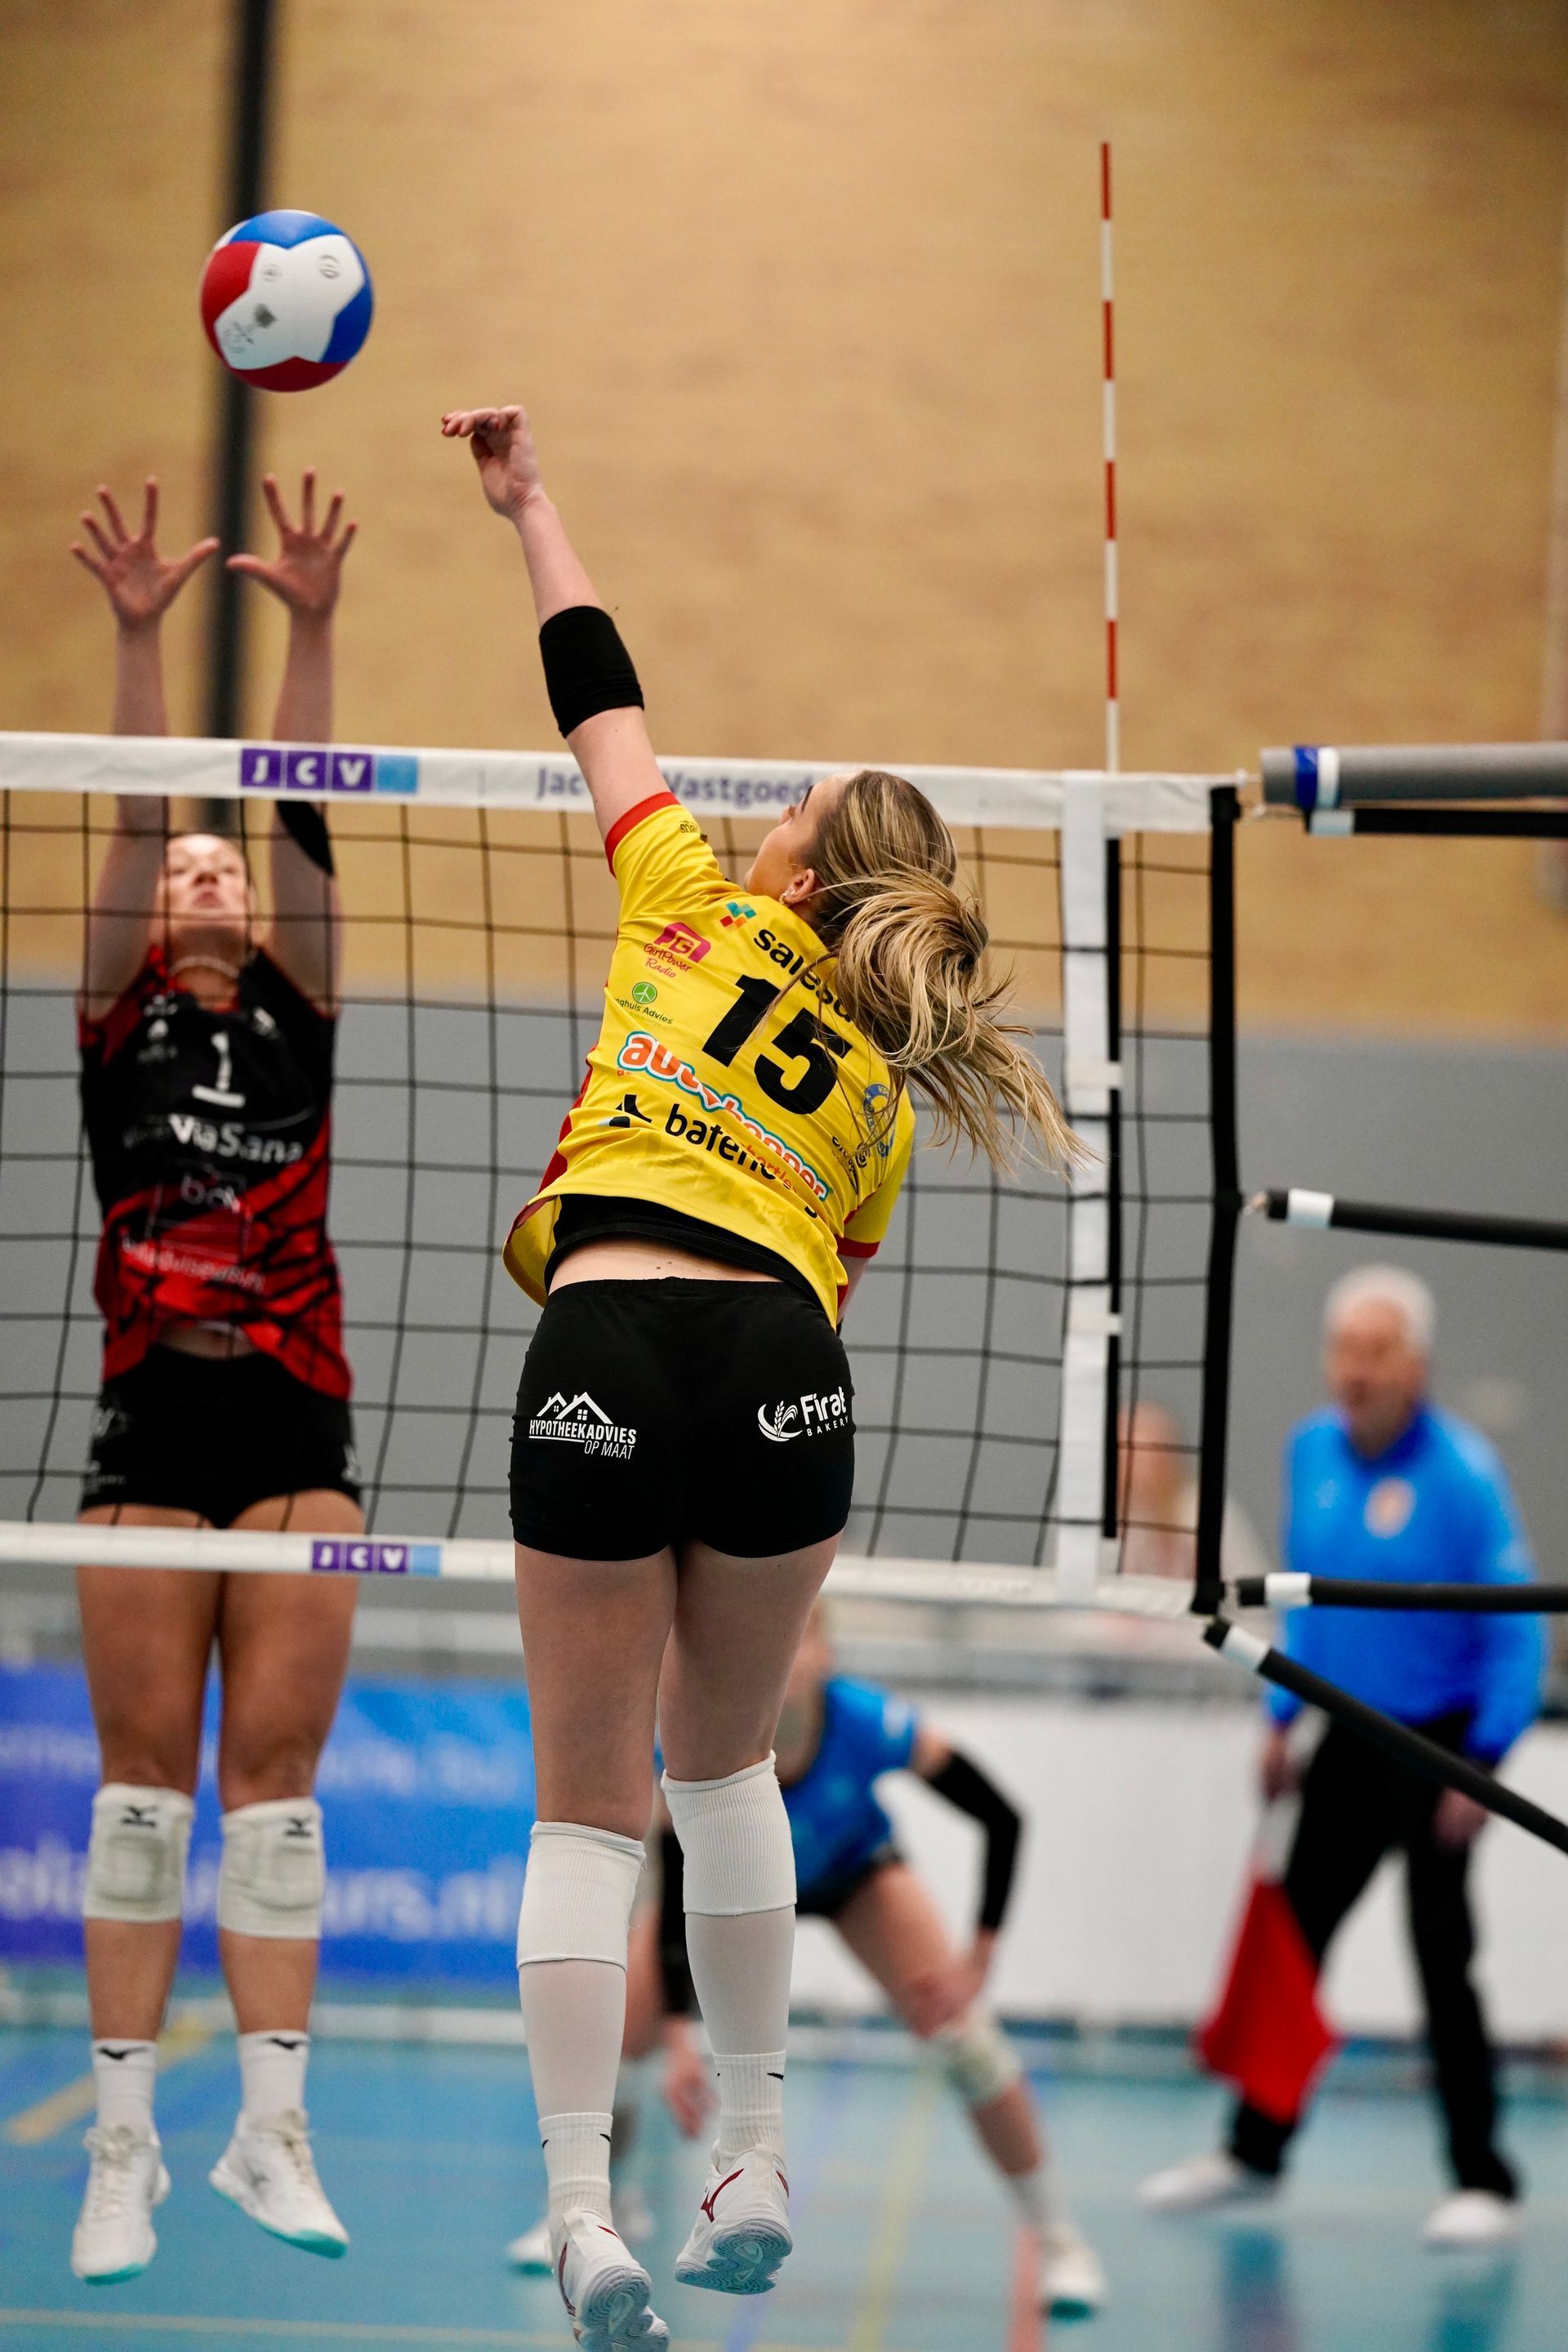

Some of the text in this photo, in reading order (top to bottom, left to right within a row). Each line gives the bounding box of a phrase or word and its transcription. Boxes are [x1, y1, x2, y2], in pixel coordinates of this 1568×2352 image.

[252, 755, 367, 788] JCV
[645, 957, 677, 978] Radio
[642, 1006, 674, 1025] Advies
[702, 973, 853, 1116] 15
[191, 1031, 246, 1109] 1
[800, 1386, 848, 1425] Firat
[529, 1419, 637, 1445] HYPOTHEEKADVIES
[806, 1414, 849, 1437] BAKERY
[584, 1440, 635, 1459] OP MAAT
